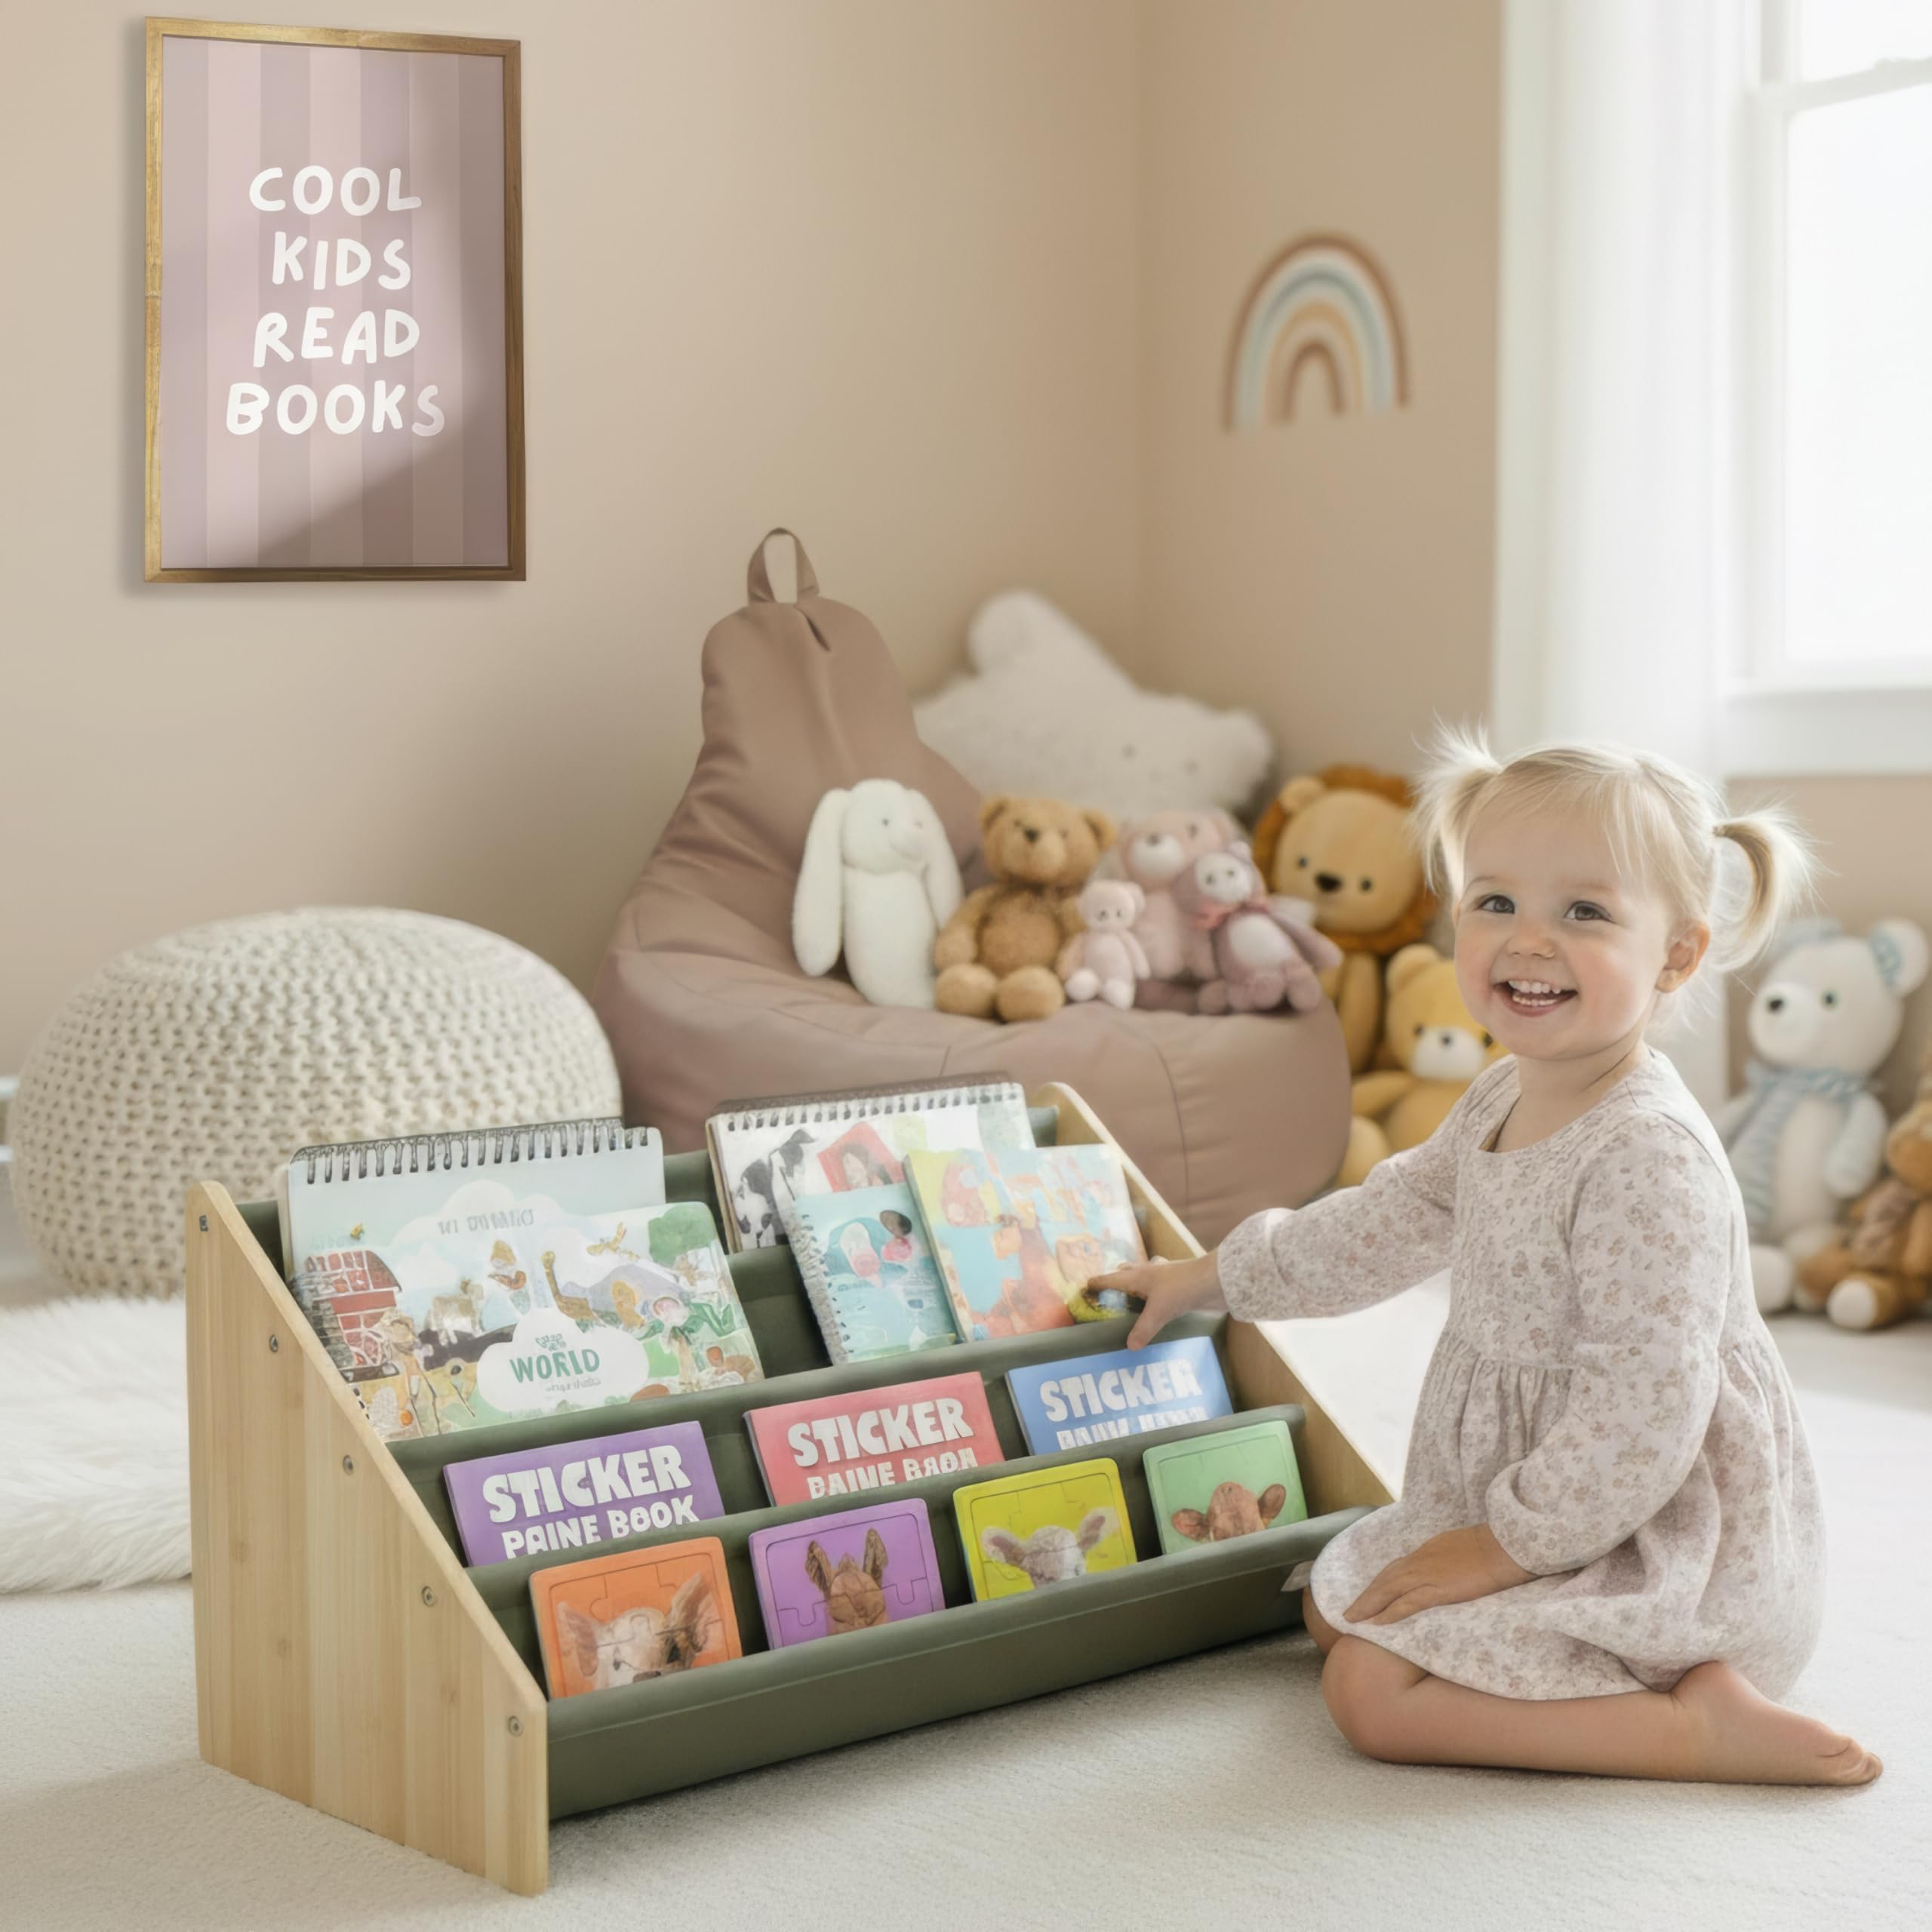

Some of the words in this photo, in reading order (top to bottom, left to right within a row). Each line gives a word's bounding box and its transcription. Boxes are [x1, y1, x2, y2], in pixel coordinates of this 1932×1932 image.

[249, 165, 422, 216] COOL
[272, 231, 411, 290] KIDS
[253, 306, 420, 368] READ
[226, 380, 445, 437] BOOKS
[1040, 1358, 1204, 1422] STICKER
[788, 1398, 974, 1467] STICKER
[483, 1444, 692, 1523] STICKER
[501, 1515, 601, 1559] PAINE
[608, 1495, 700, 1539] BOOK
